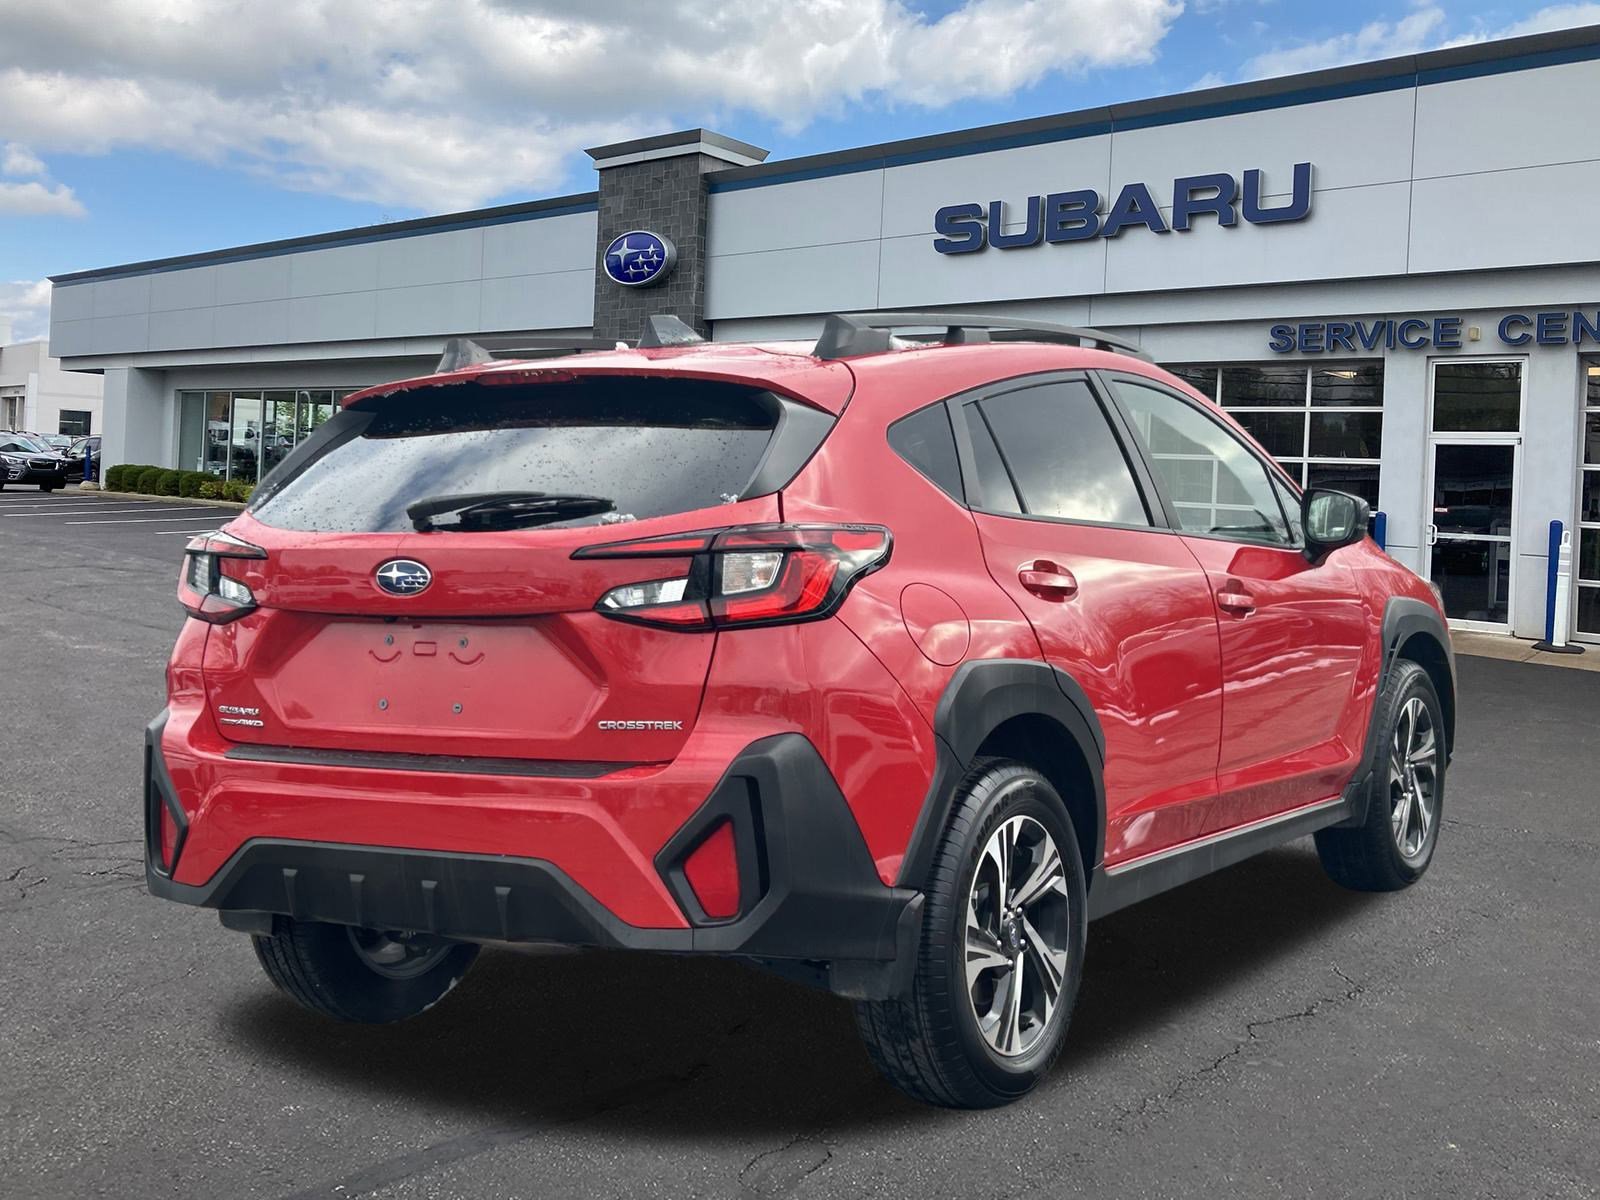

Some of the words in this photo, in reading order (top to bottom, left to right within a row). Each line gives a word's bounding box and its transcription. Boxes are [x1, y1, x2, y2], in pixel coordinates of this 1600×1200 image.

[933, 161, 1313, 255] SUBARU
[1268, 317, 1464, 353] SERVICE
[218, 705, 260, 715] SUBARU
[598, 720, 683, 730] CROSSTREK
